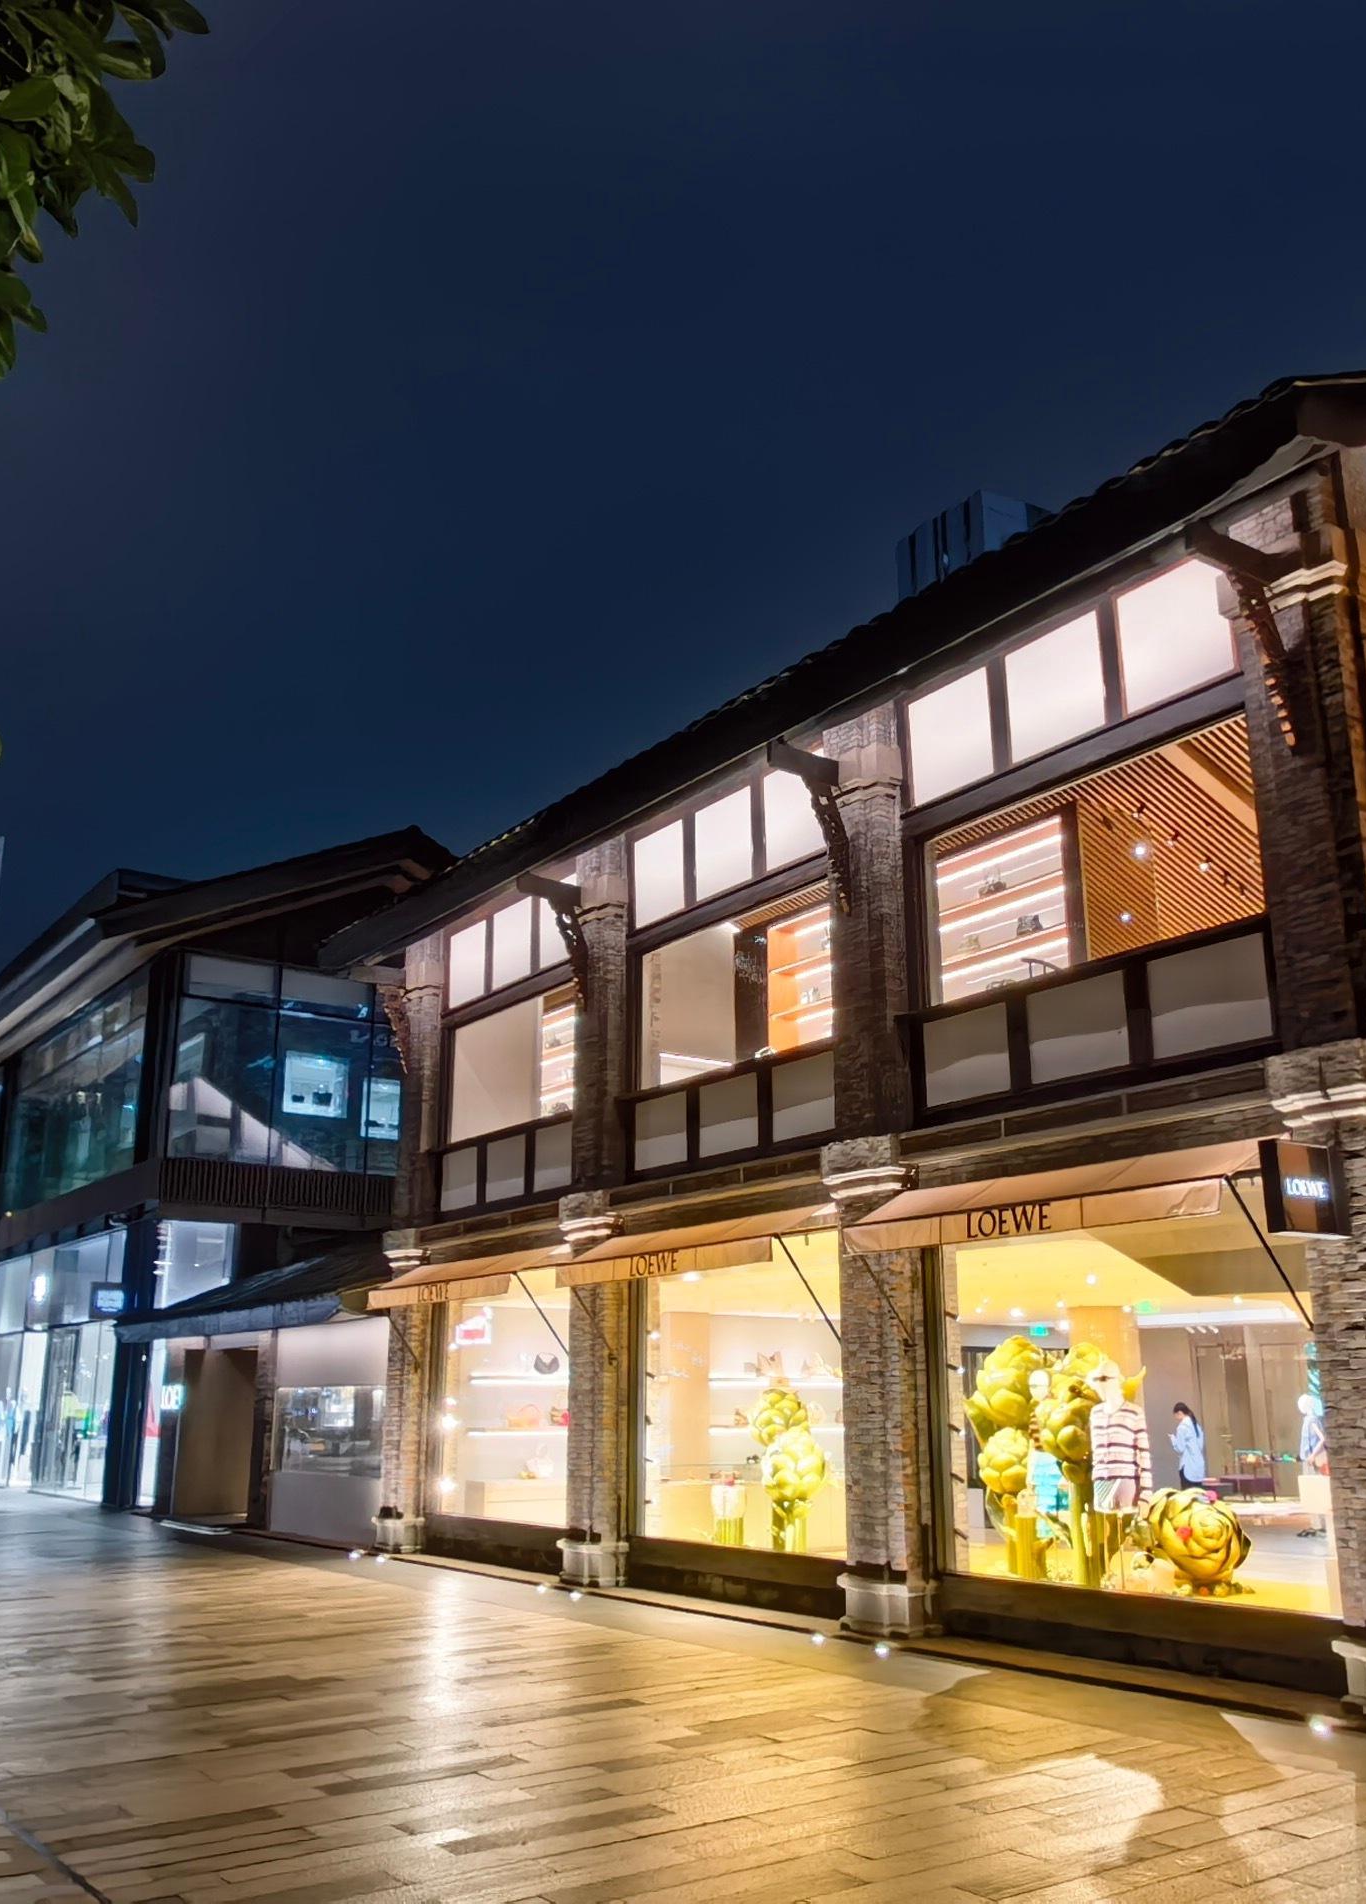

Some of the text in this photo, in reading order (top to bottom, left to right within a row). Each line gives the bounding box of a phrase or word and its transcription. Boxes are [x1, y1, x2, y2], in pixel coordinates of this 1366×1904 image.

[1286, 1178, 1329, 1199] LOEWE
[966, 1202, 1051, 1239] LOEWE
[629, 1249, 679, 1277] LOEWE
